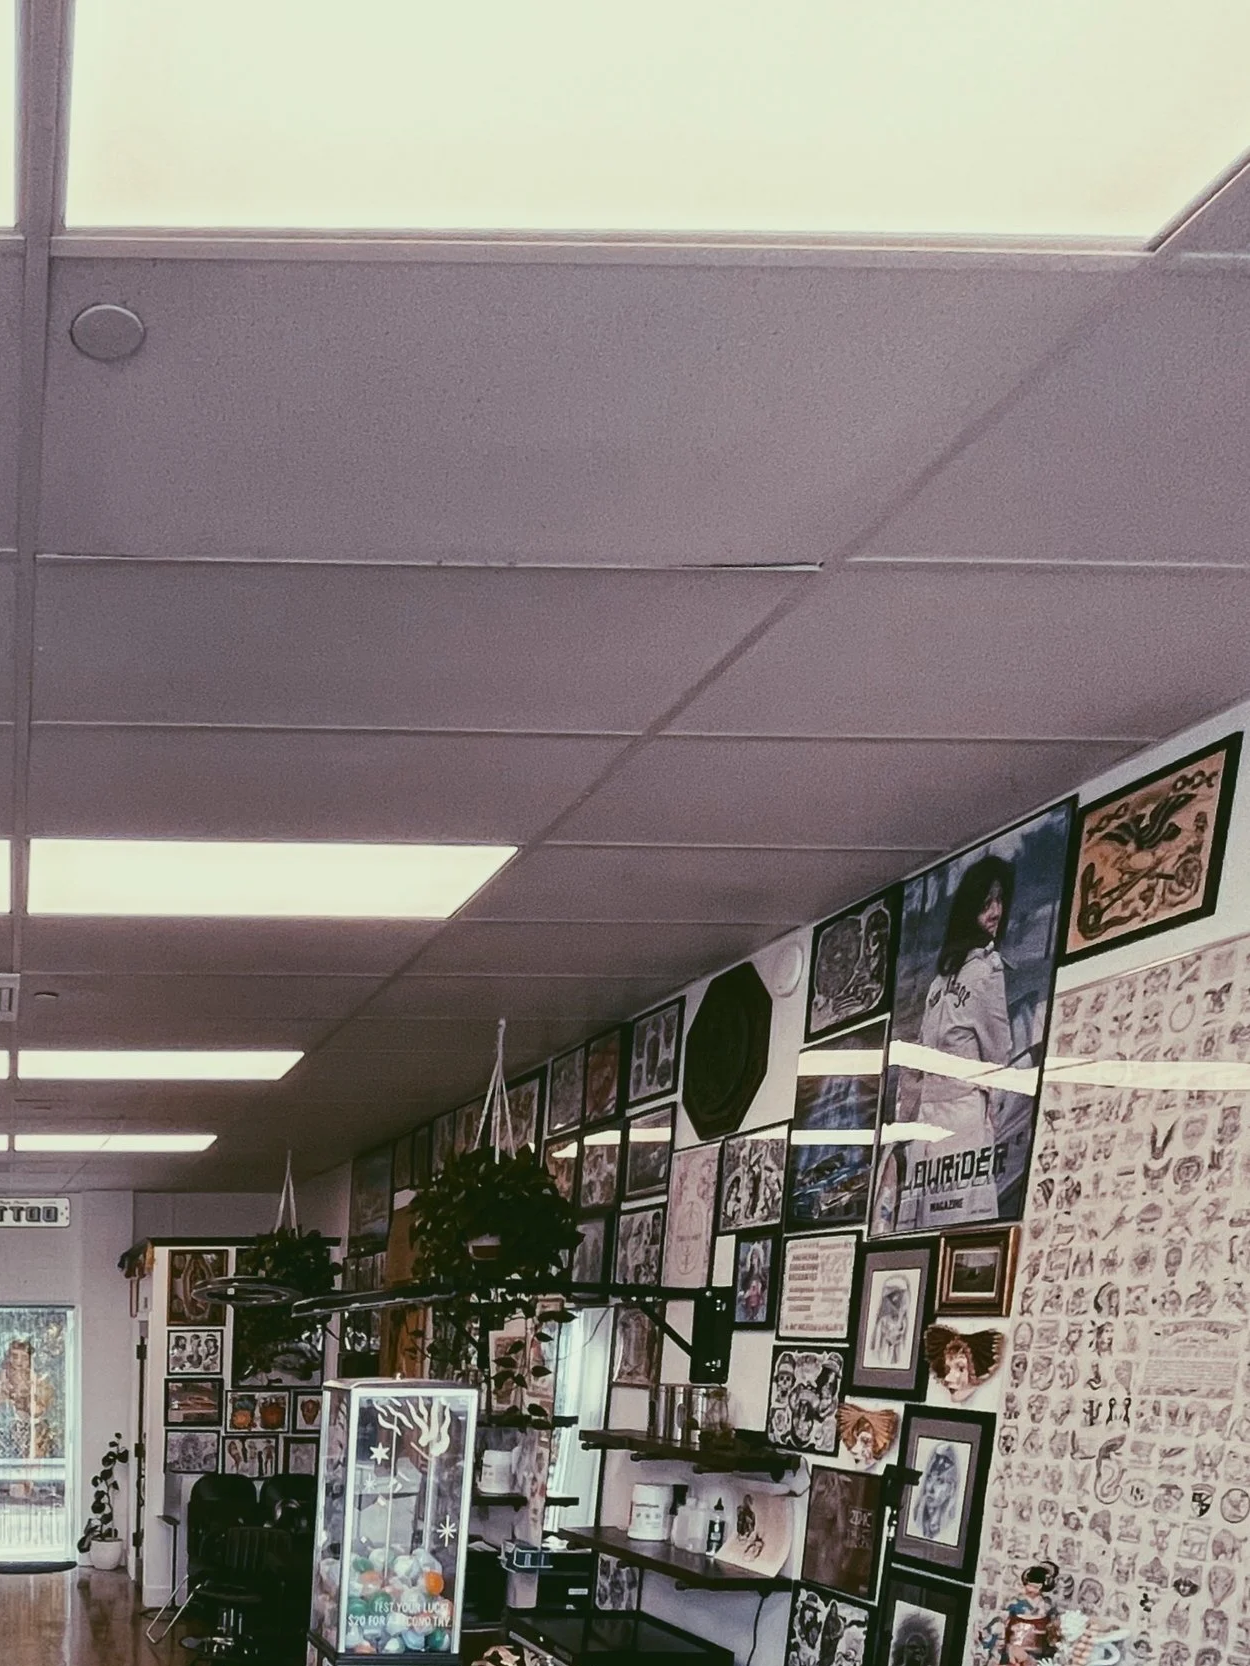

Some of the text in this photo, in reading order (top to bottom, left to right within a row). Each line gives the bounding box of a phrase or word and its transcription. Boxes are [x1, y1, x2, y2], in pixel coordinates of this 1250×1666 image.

[900, 1142, 1009, 1191] LOWRIDER
[929, 1198, 964, 1212] MAGAZINE
[374, 1601, 394, 1612] TEST
[396, 1601, 421, 1612] YOUR
[348, 1615, 365, 1627] $20
[368, 1615, 385, 1626] FOR
